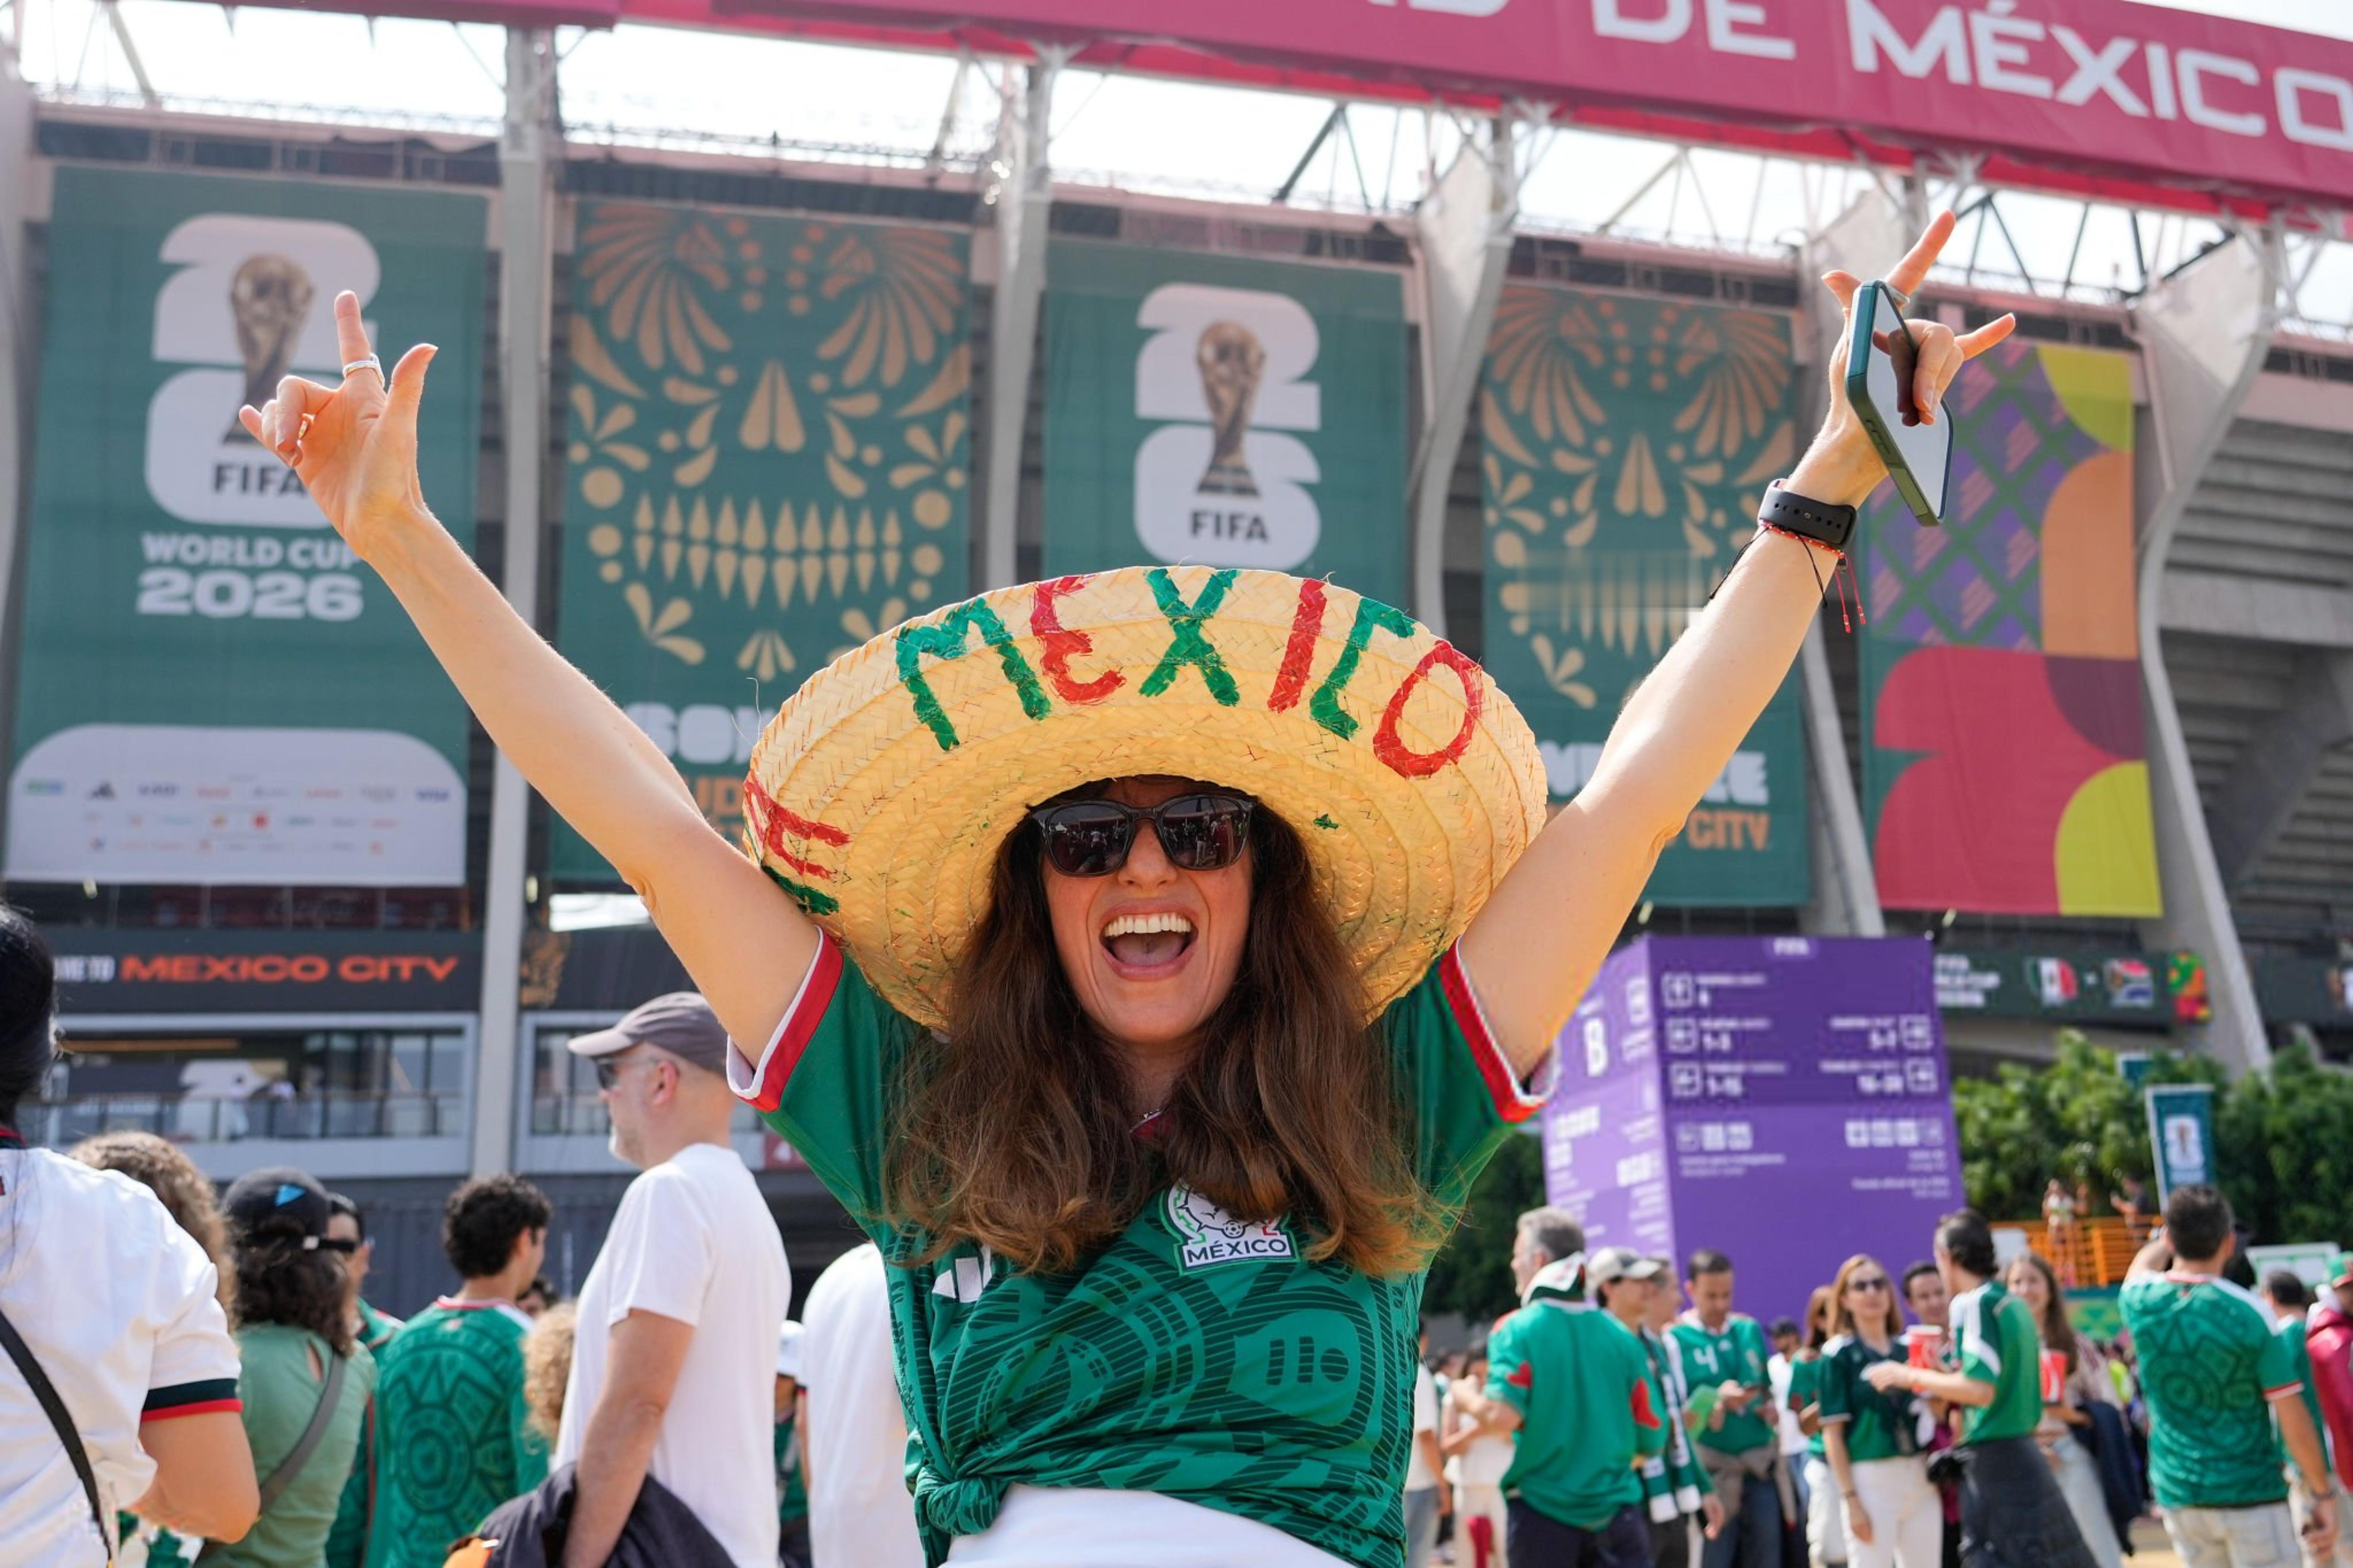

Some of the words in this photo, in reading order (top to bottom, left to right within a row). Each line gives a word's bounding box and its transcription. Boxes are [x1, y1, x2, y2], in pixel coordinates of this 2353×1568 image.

[214, 463, 309, 496] FIFA
[1191, 510, 1269, 542] FIFA
[142, 532, 283, 567] WORLD
[136, 567, 365, 621] 2026
[895, 568, 1484, 779] MEXICO
[1688, 809, 1770, 851] CITY
[120, 955, 329, 983] MEXICO
[338, 955, 458, 983] CITY
[1186, 1239, 1287, 1263] MÉXICO
